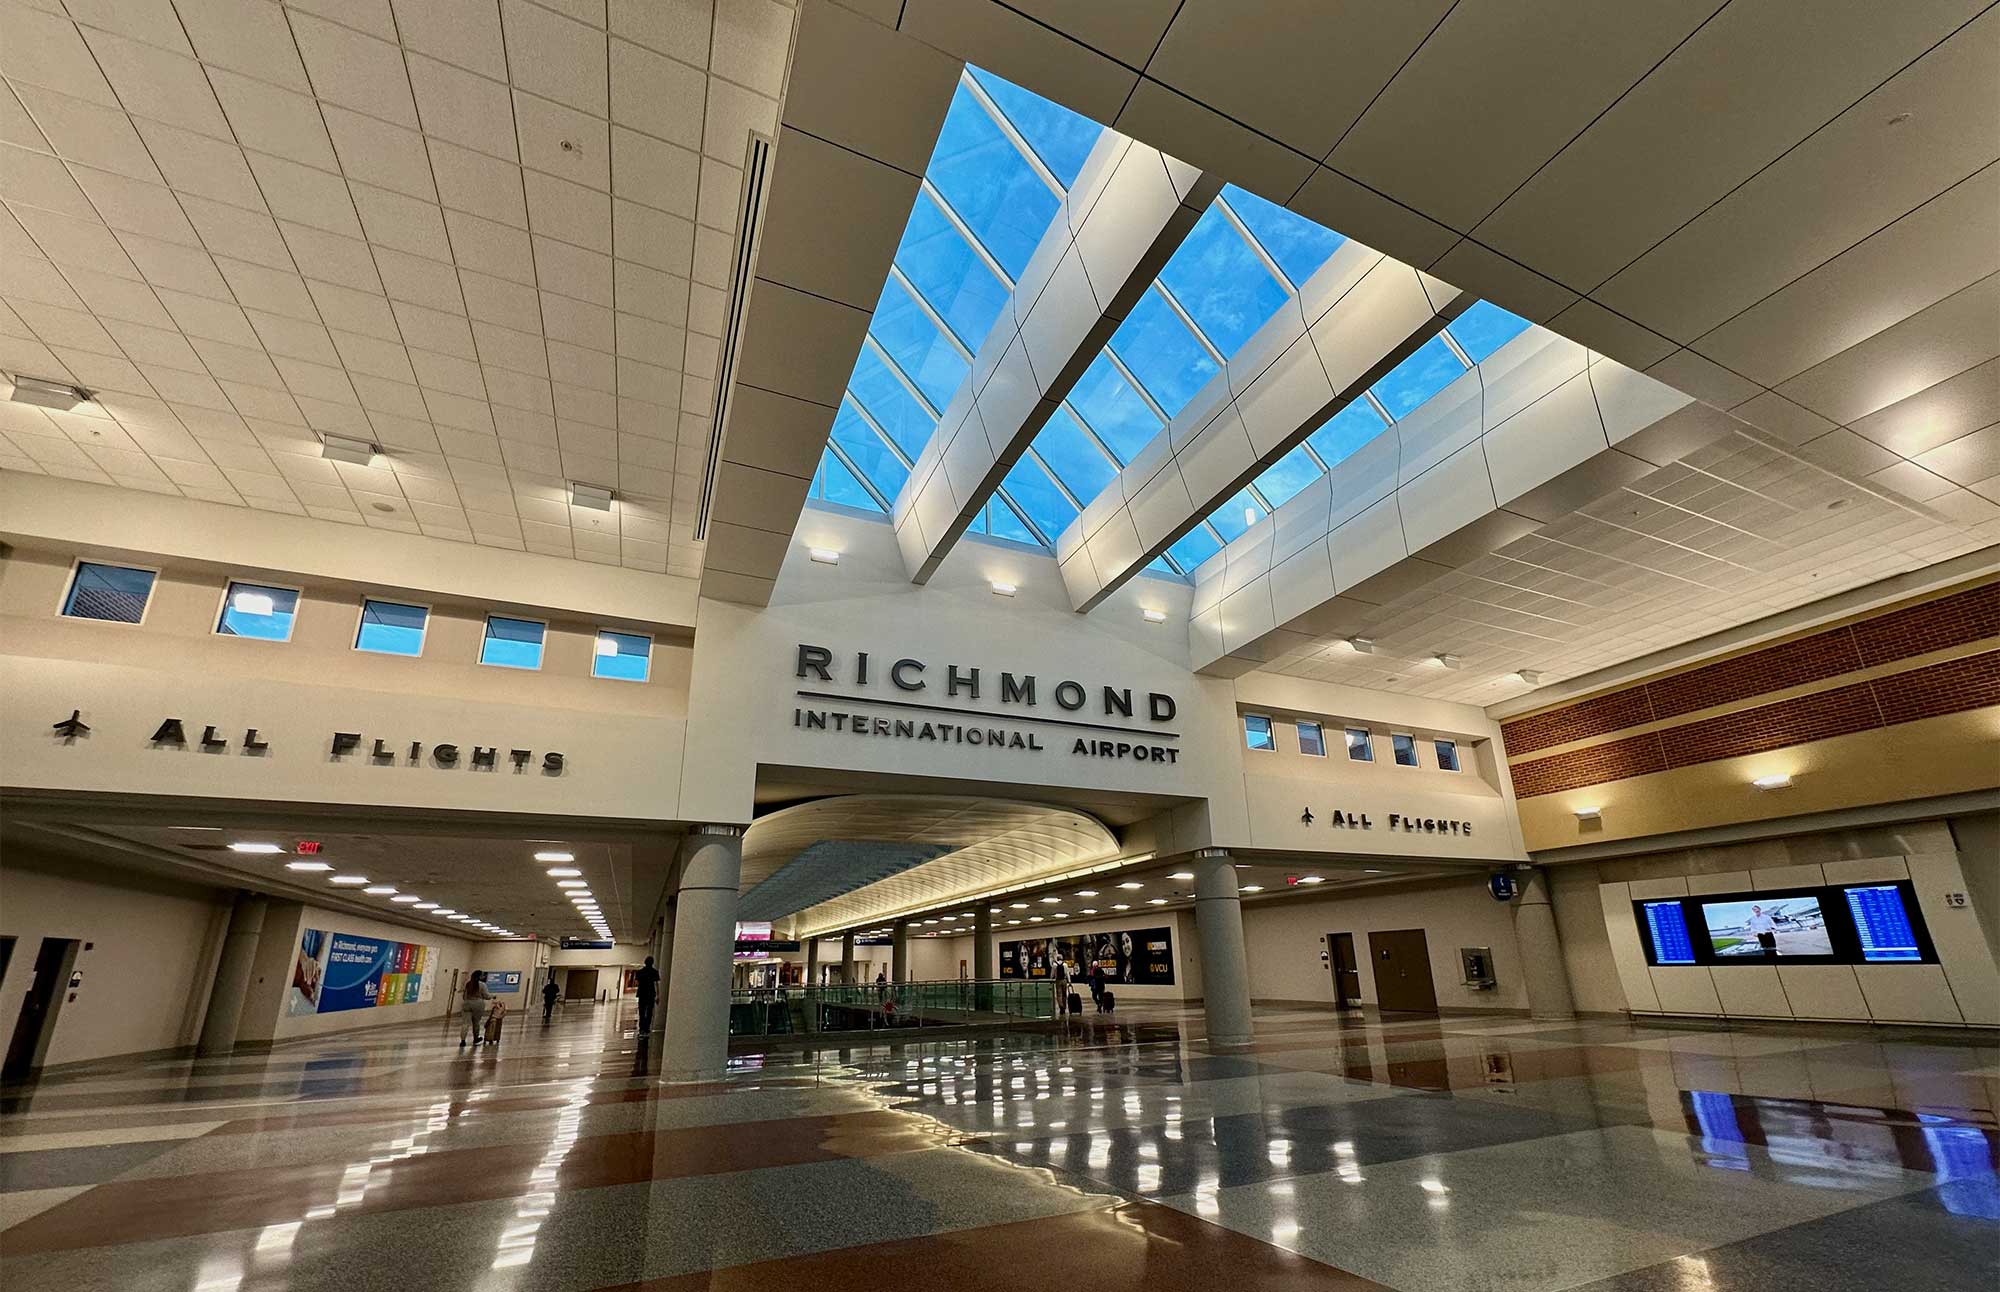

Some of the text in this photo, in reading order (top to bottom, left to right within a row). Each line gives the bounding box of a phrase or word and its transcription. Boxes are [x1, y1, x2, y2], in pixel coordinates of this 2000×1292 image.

[796, 644, 1177, 721] RICHMOND
[150, 718, 565, 770] ALL FLIGHTS
[795, 708, 1180, 763] INTERNATIONAL AIRPORT
[1332, 810, 1472, 834] ALL FLIGHTS
[297, 841, 320, 854] EXIT
[331, 952, 343, 962] FIRST
[343, 953, 354, 963] CLASS
[1154, 963, 1168, 973] VCU
